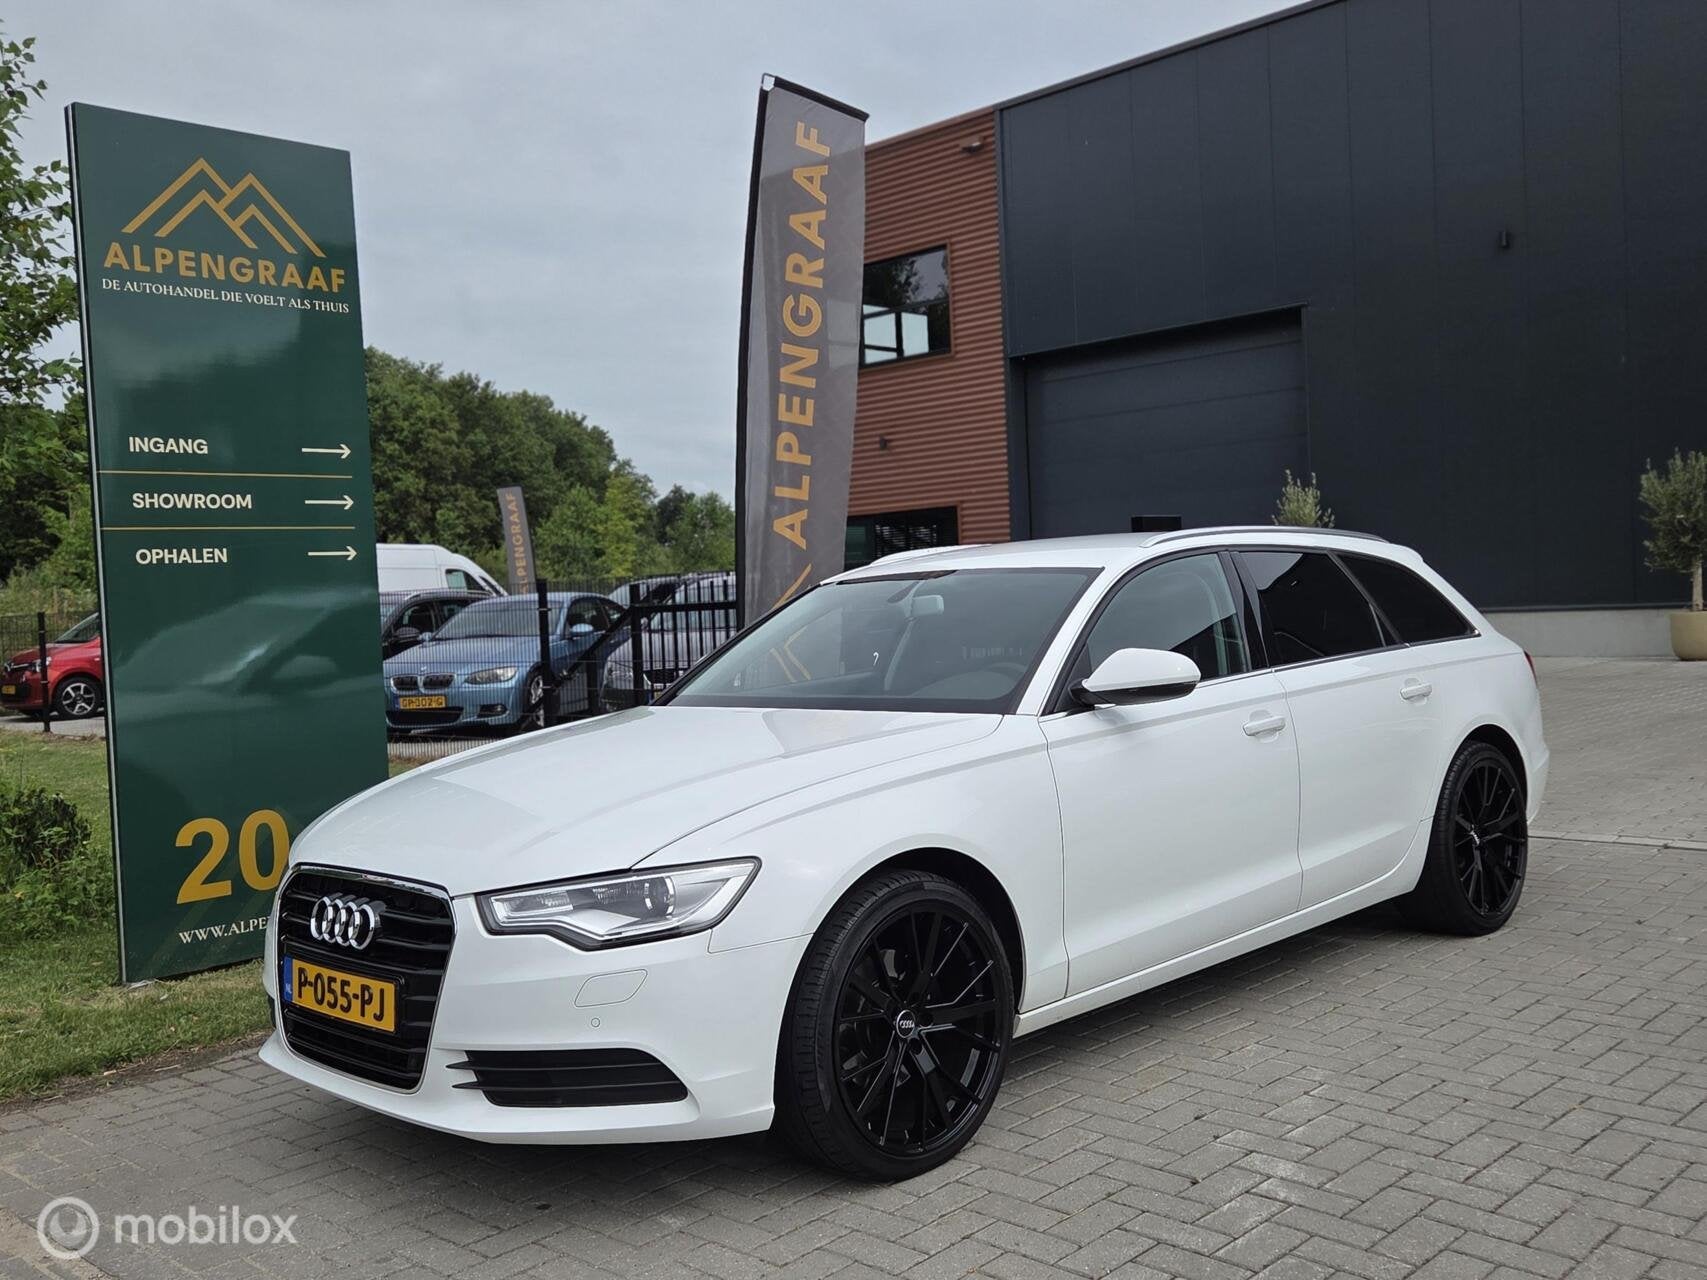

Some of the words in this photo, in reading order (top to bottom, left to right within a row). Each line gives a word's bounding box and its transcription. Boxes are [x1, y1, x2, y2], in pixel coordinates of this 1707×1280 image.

[103, 242, 345, 293] ALPENGRAAF
[102, 278, 121, 291] DE
[124, 280, 219, 300] AUTOHANDEL
[221, 290, 243, 303] DIE
[245, 292, 286, 307] VOELT
[288, 298, 311, 310] ALS
[312, 300, 350, 314] THUIS
[772, 121, 832, 550] ALPENGRAAF
[128, 436, 209, 454] INGANG
[132, 492, 252, 509] SHOWROOM
[135, 548, 228, 565] OPHALEN
[175, 809, 290, 904] 20
[178, 916, 271, 944] WWW.ALPE
[297, 967, 385, 1022] P-055-PJ
